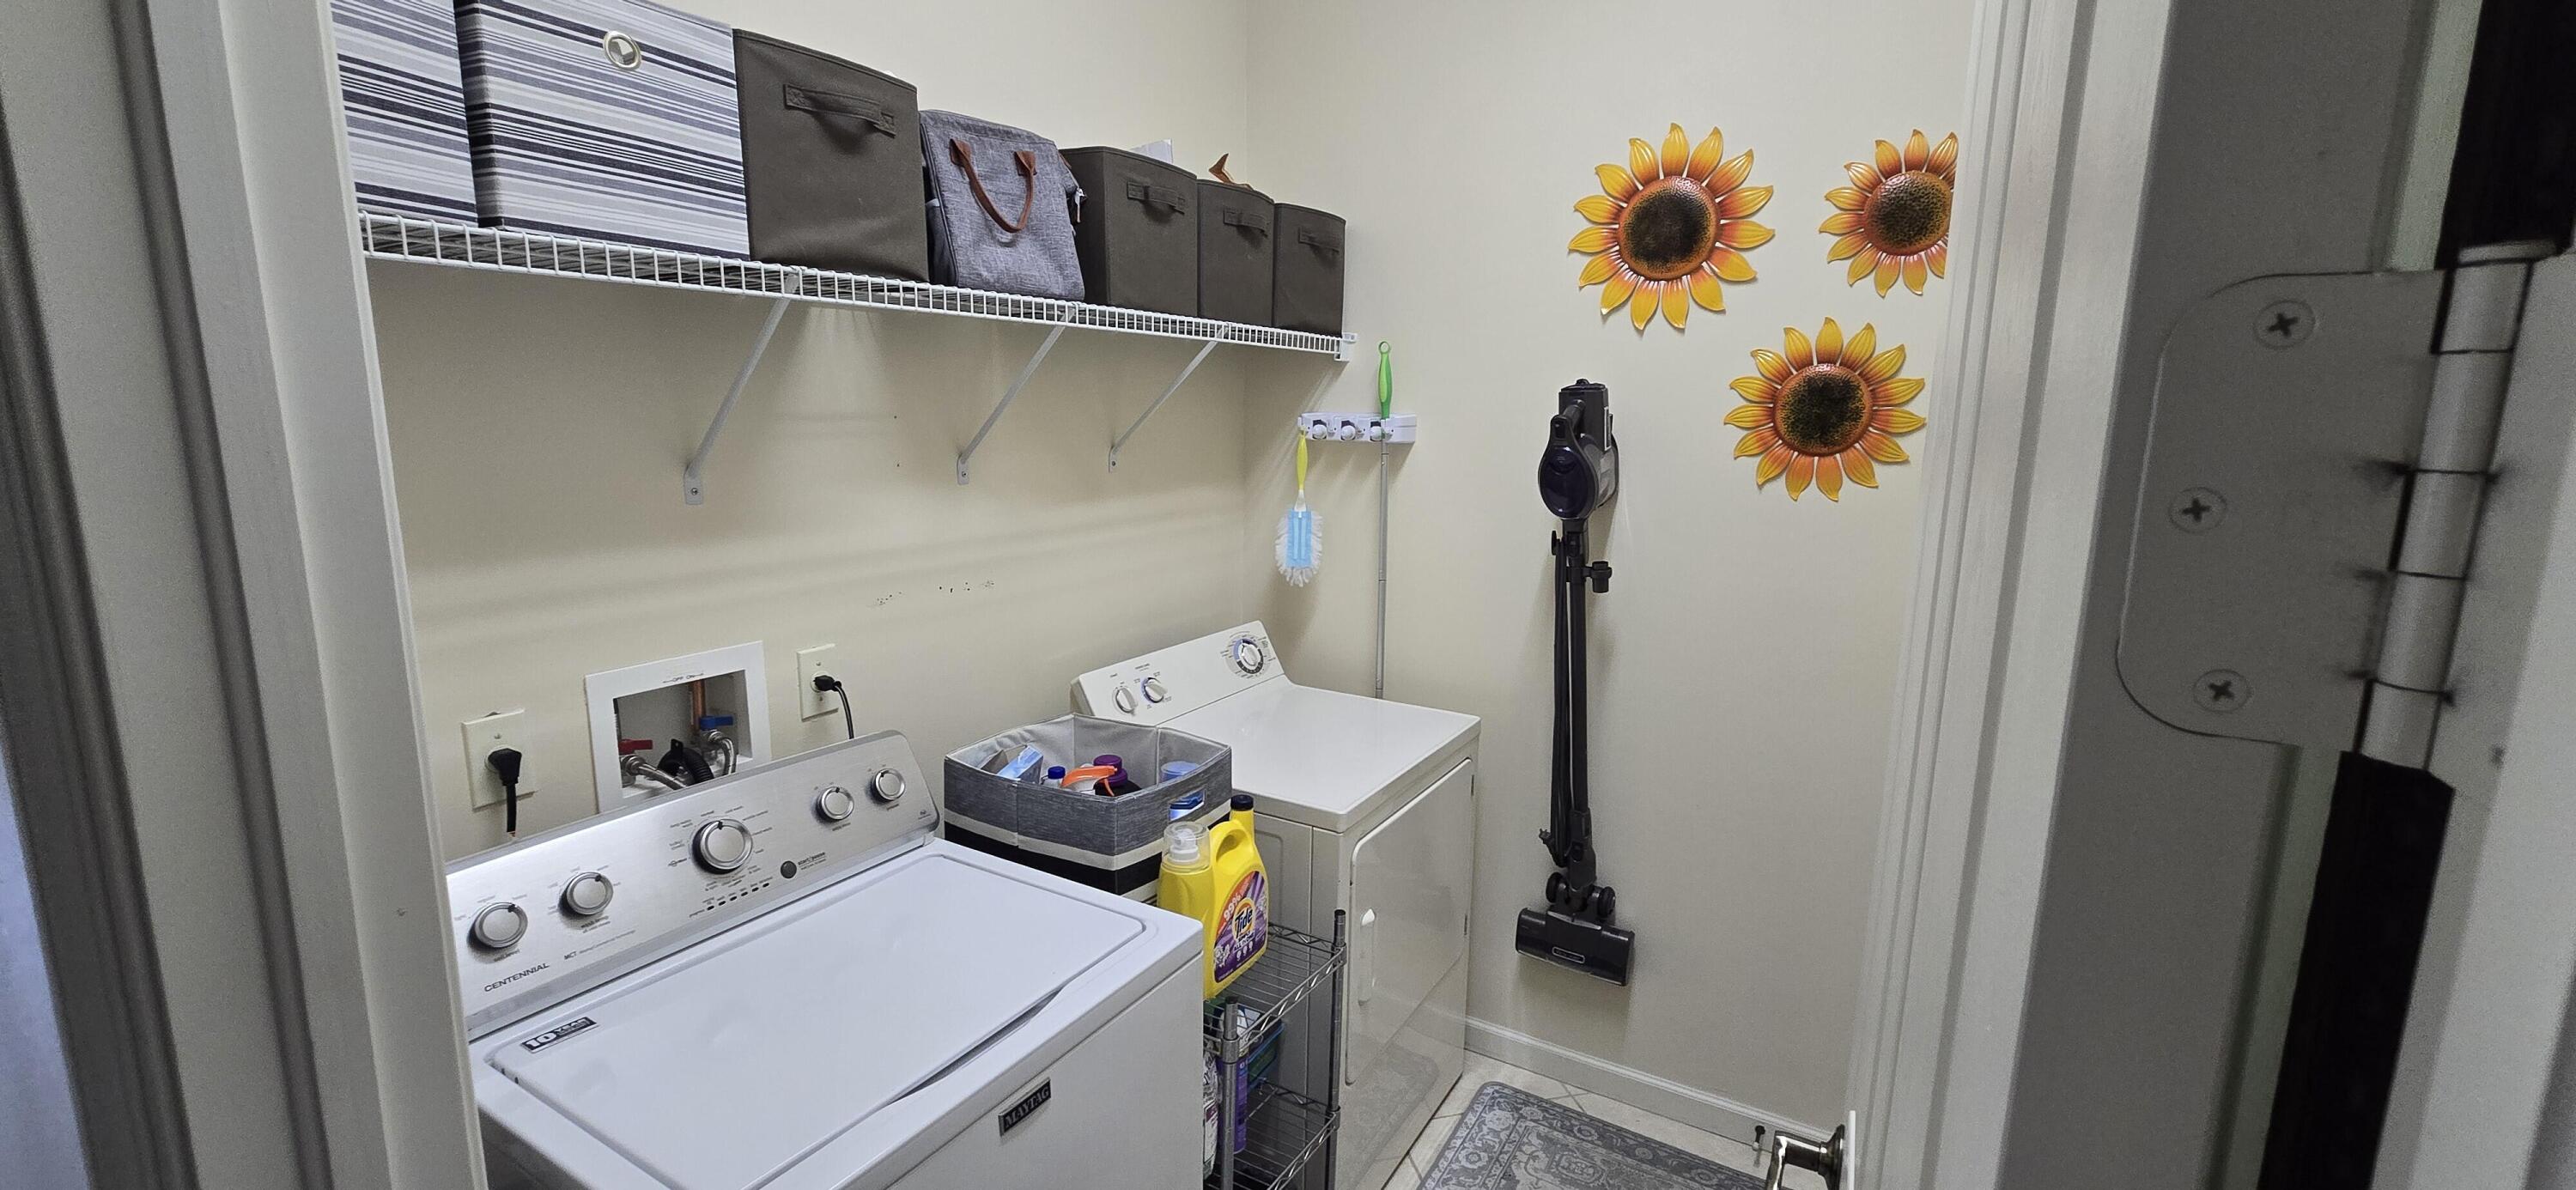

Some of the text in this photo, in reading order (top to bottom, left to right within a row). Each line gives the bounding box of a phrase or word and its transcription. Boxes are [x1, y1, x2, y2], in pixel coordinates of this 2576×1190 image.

[1235, 907, 1254, 938] Tide
[484, 962, 550, 993] CENTENNIAL
[526, 1032, 557, 1047] 10
[1004, 1085, 1049, 1128] MAYTAG
